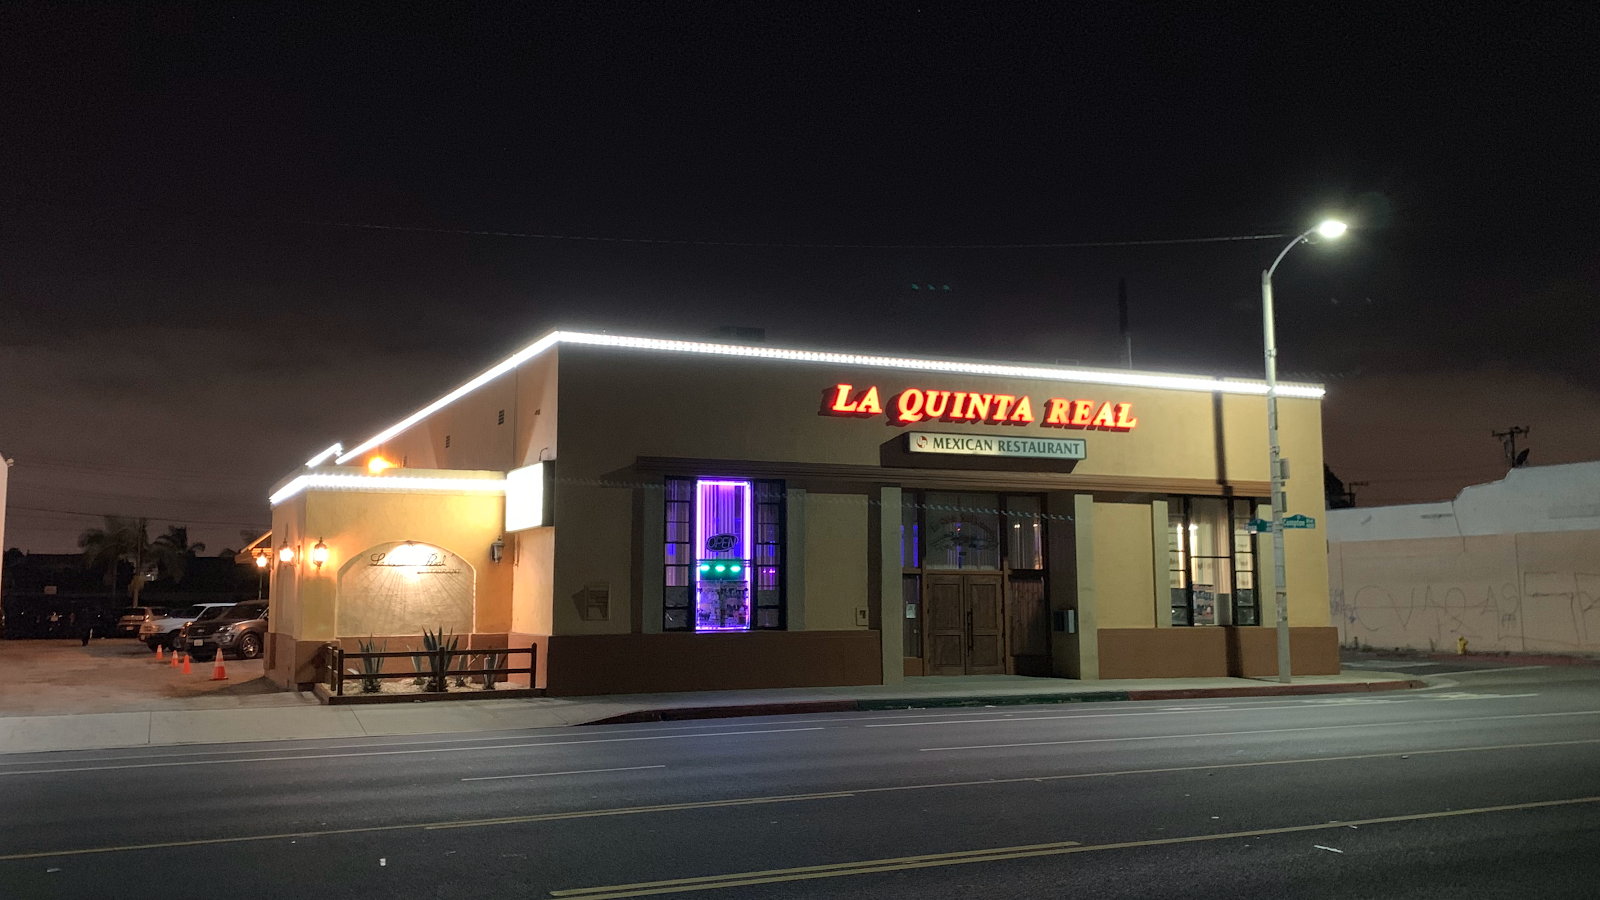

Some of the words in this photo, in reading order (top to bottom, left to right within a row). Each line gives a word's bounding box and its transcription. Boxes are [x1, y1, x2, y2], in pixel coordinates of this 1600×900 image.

[832, 384, 882, 413] LA
[898, 388, 1034, 422] QUINTA
[1046, 398, 1137, 428] REAL
[933, 437, 993, 452] MEXICAN
[998, 440, 1080, 455] RESTAURANT
[708, 536, 737, 549] OPEN
